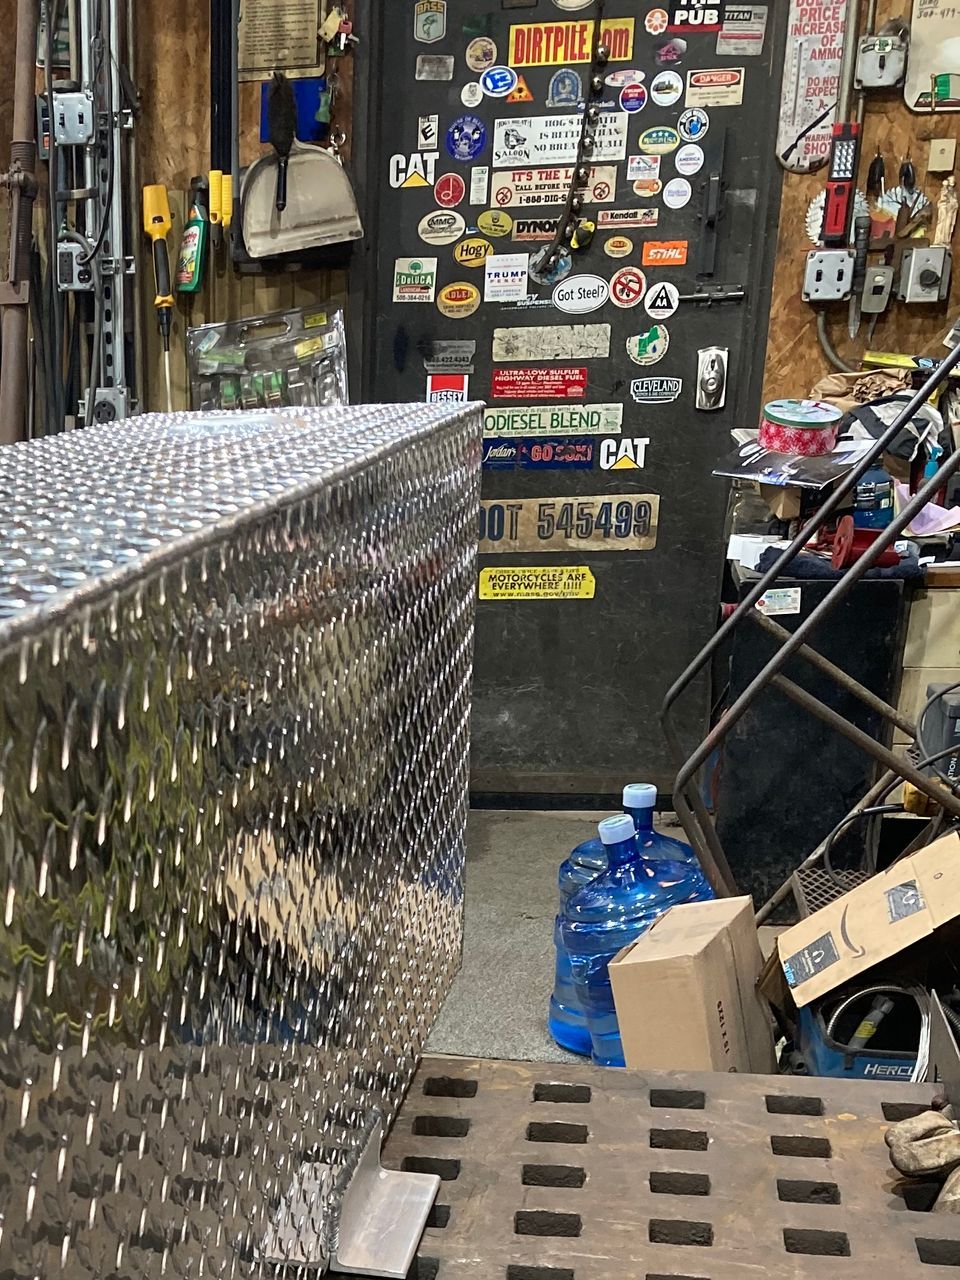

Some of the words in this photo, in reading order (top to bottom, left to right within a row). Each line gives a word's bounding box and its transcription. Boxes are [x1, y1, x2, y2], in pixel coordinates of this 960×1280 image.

[674, 9, 719, 25] PUB
[724, 12, 751, 20] TITAN
[799, 6, 841, 22] PRICE
[514, 24, 630, 64] DIRTPILE.om
[821, 35, 837, 46] OF
[810, 47, 844, 61] AMMO
[700, 74, 732, 82] DANGER
[807, 77, 820, 87] DO
[823, 76, 840, 86] NOT
[576, 116, 618, 126] BATH
[421, 123, 435, 141] E
[551, 130, 588, 138] BETTE
[494, 149, 531, 160] SALOON
[389, 152, 440, 188] CAT
[538, 169, 561, 181] THE
[535, 182, 560, 190] BEFORE
[519, 193, 585, 204] 1-888-DIG-SE
[610, 211, 639, 220] Kendall
[460, 244, 490, 258] Hogy
[648, 248, 683, 260] STIHL
[487, 270, 527, 279] TRUMP
[557, 289, 574, 301] Got
[579, 284, 605, 299] Steel?
[633, 380, 679, 392] CLEVELAND
[550, 411, 601, 429] BLEND
[531, 444, 552, 462] GO
[599, 437, 650, 470] CAT
[537, 500, 652, 541] 545499
[488, 573, 563, 582] MOTORCYCLES
[567, 572, 587, 581] ARE
[492, 581, 559, 590] EVERYWHERE
